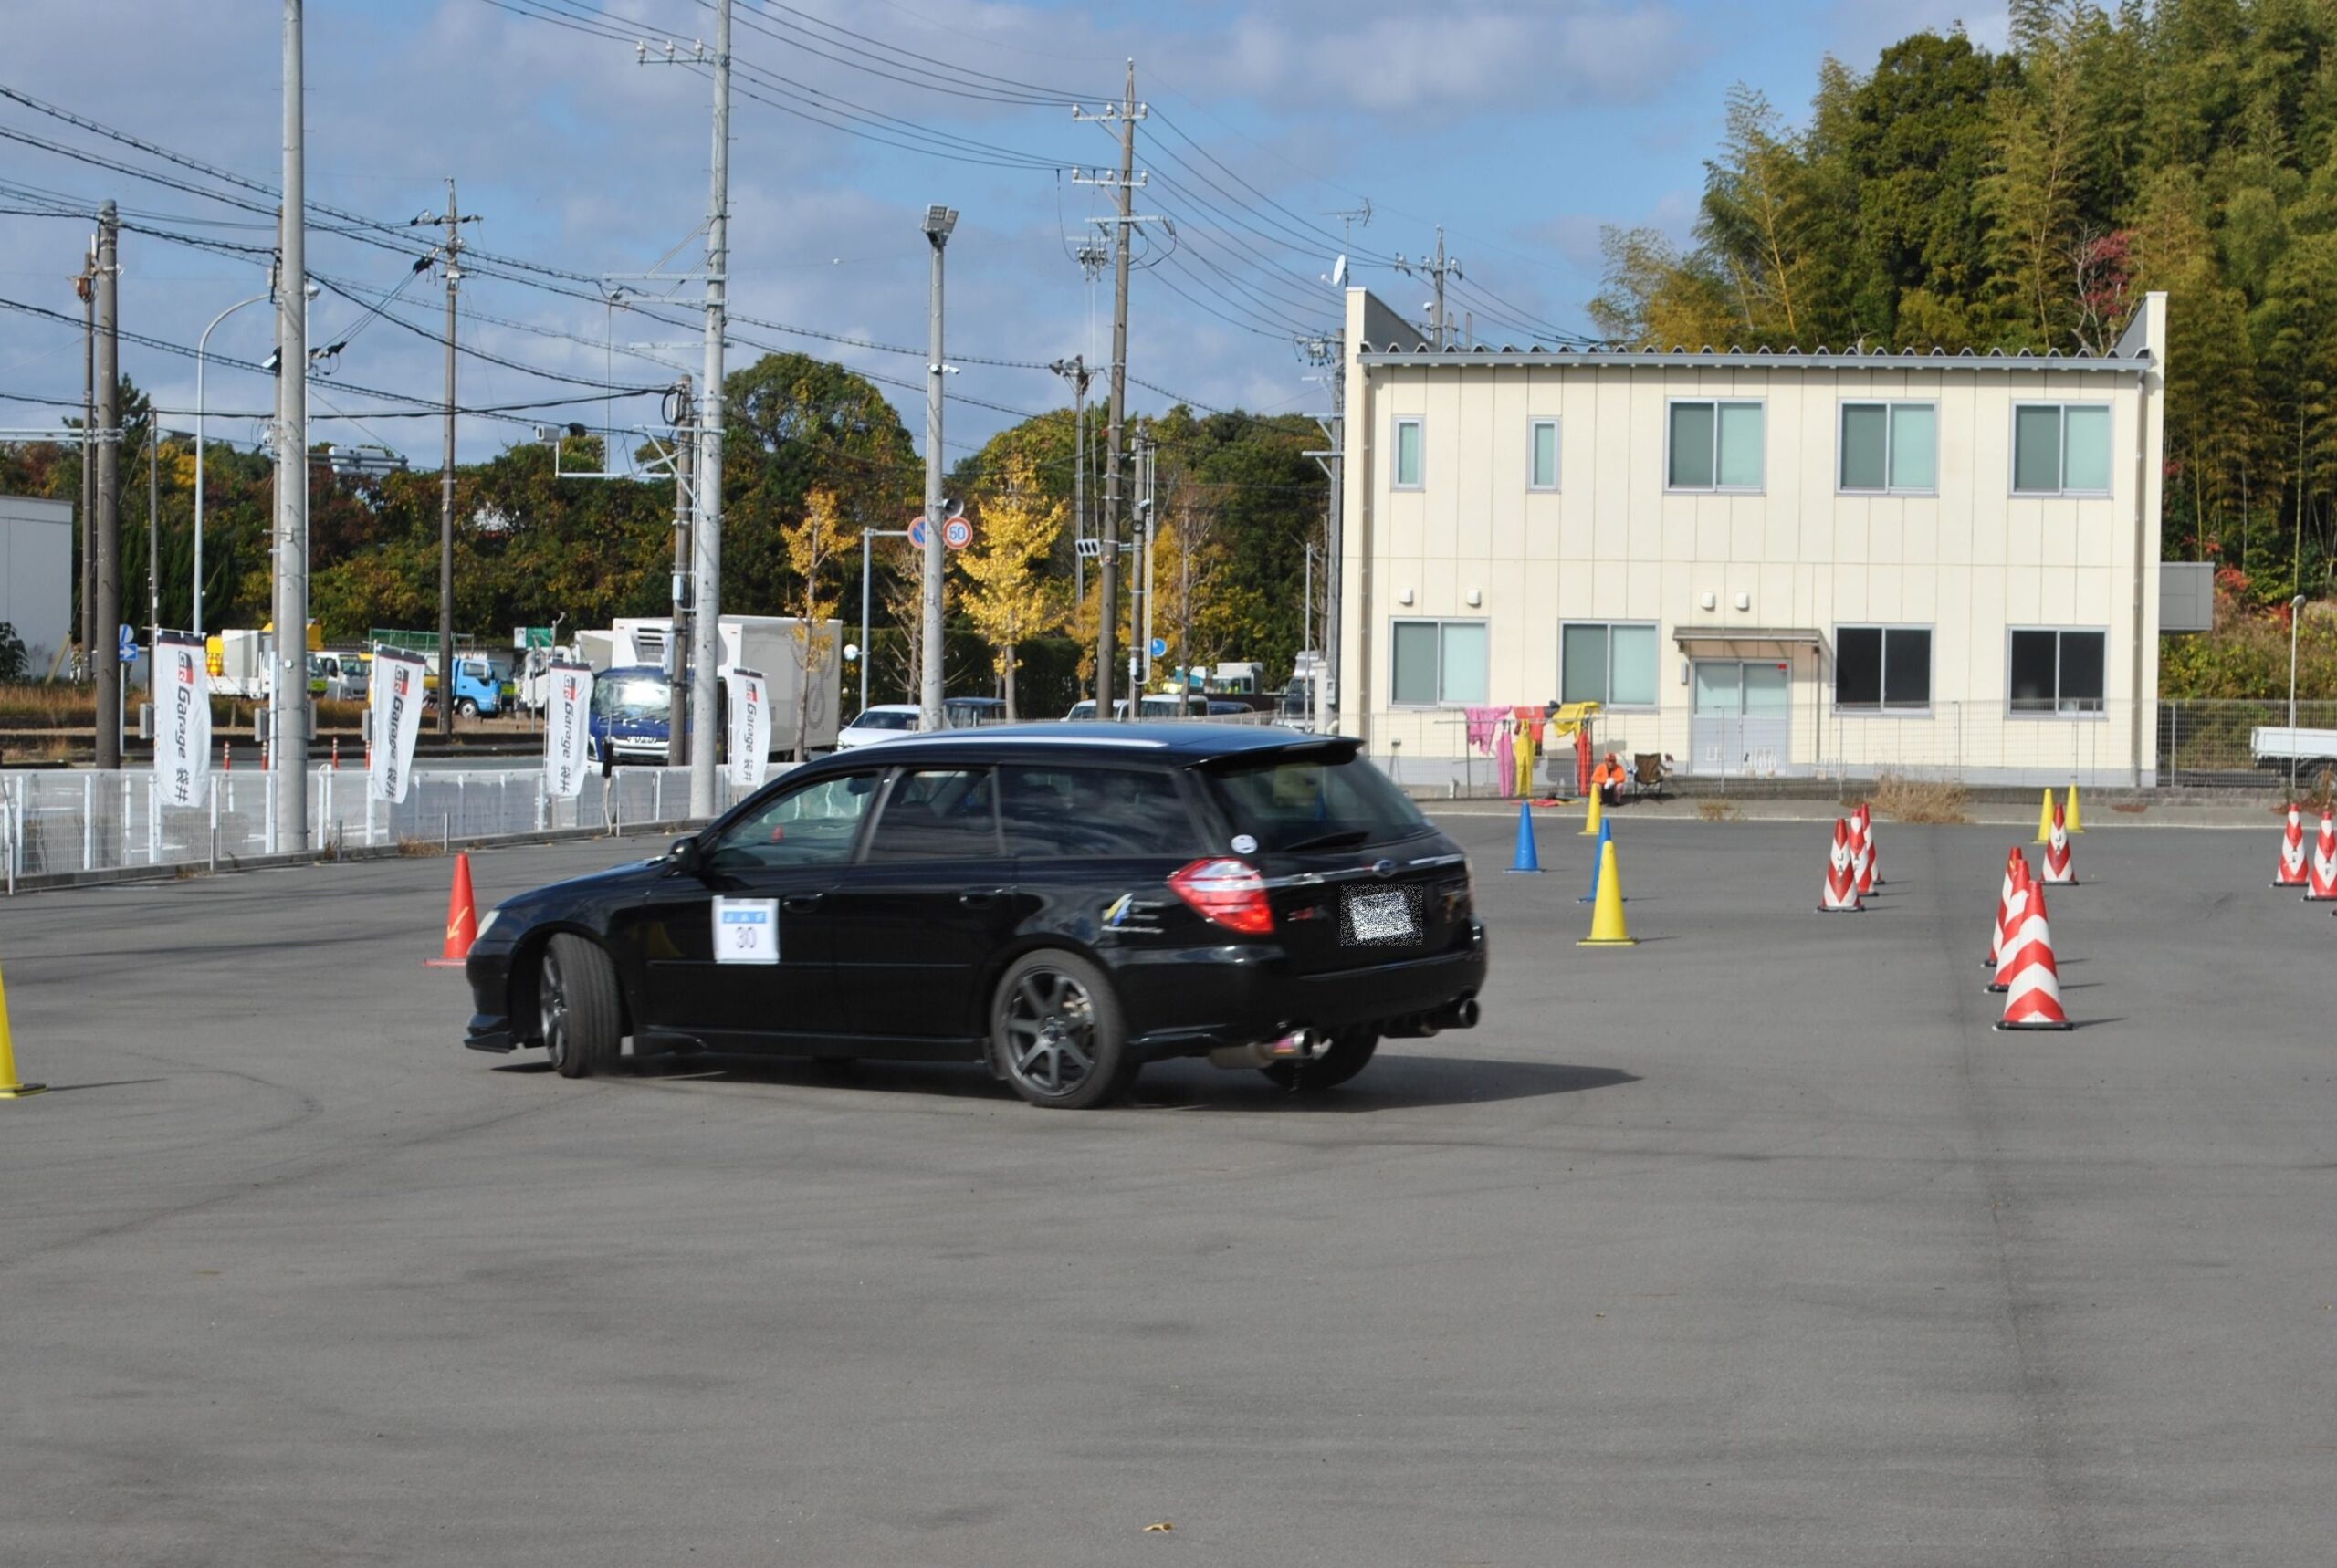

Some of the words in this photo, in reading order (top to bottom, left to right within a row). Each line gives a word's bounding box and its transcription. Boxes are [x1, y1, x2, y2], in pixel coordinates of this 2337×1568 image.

[949, 526, 966, 540] 50
[178, 651, 194, 685] GR
[394, 665, 409, 695] GR
[175, 685, 191, 758] Garage
[388, 695, 403, 759] Garage
[561, 701, 573, 758] Garage
[744, 703, 757, 753] Garage
[735, 926, 757, 948] 30
